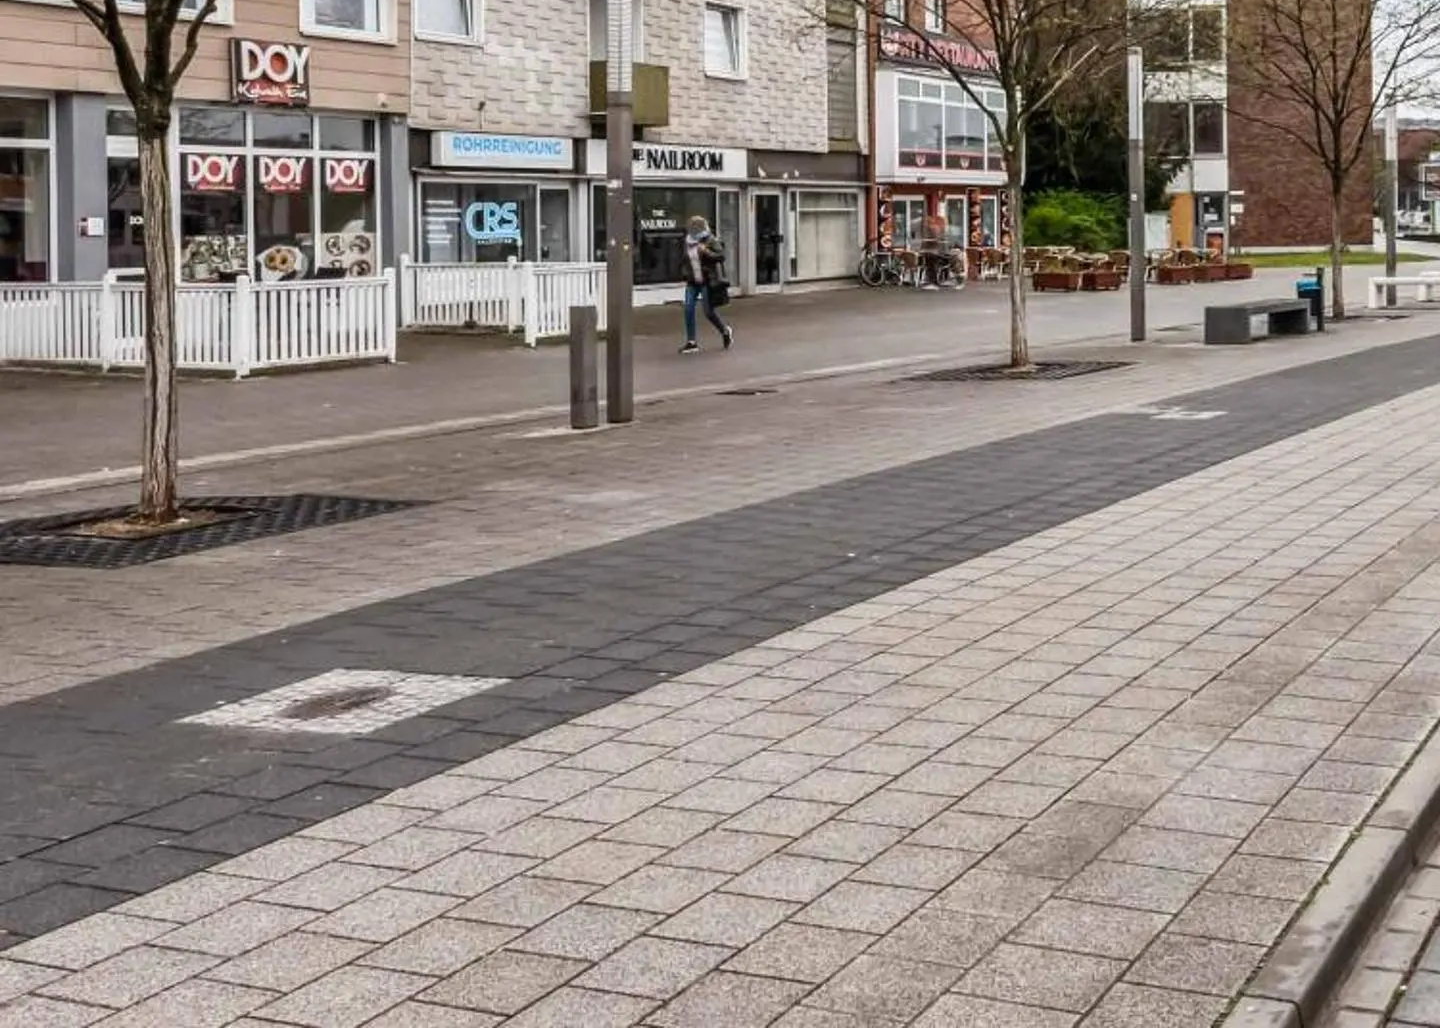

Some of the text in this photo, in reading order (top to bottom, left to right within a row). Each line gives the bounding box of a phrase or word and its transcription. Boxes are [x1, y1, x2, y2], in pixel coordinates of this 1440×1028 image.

[241, 40, 310, 84] DOY
[453, 136, 561, 155] ROHRREINIGUNG
[647, 148, 723, 171] NAILROOM
[187, 154, 239, 184] DOY
[259, 156, 306, 185] DOY
[325, 159, 368, 186] DOY
[465, 202, 520, 240] CRS
